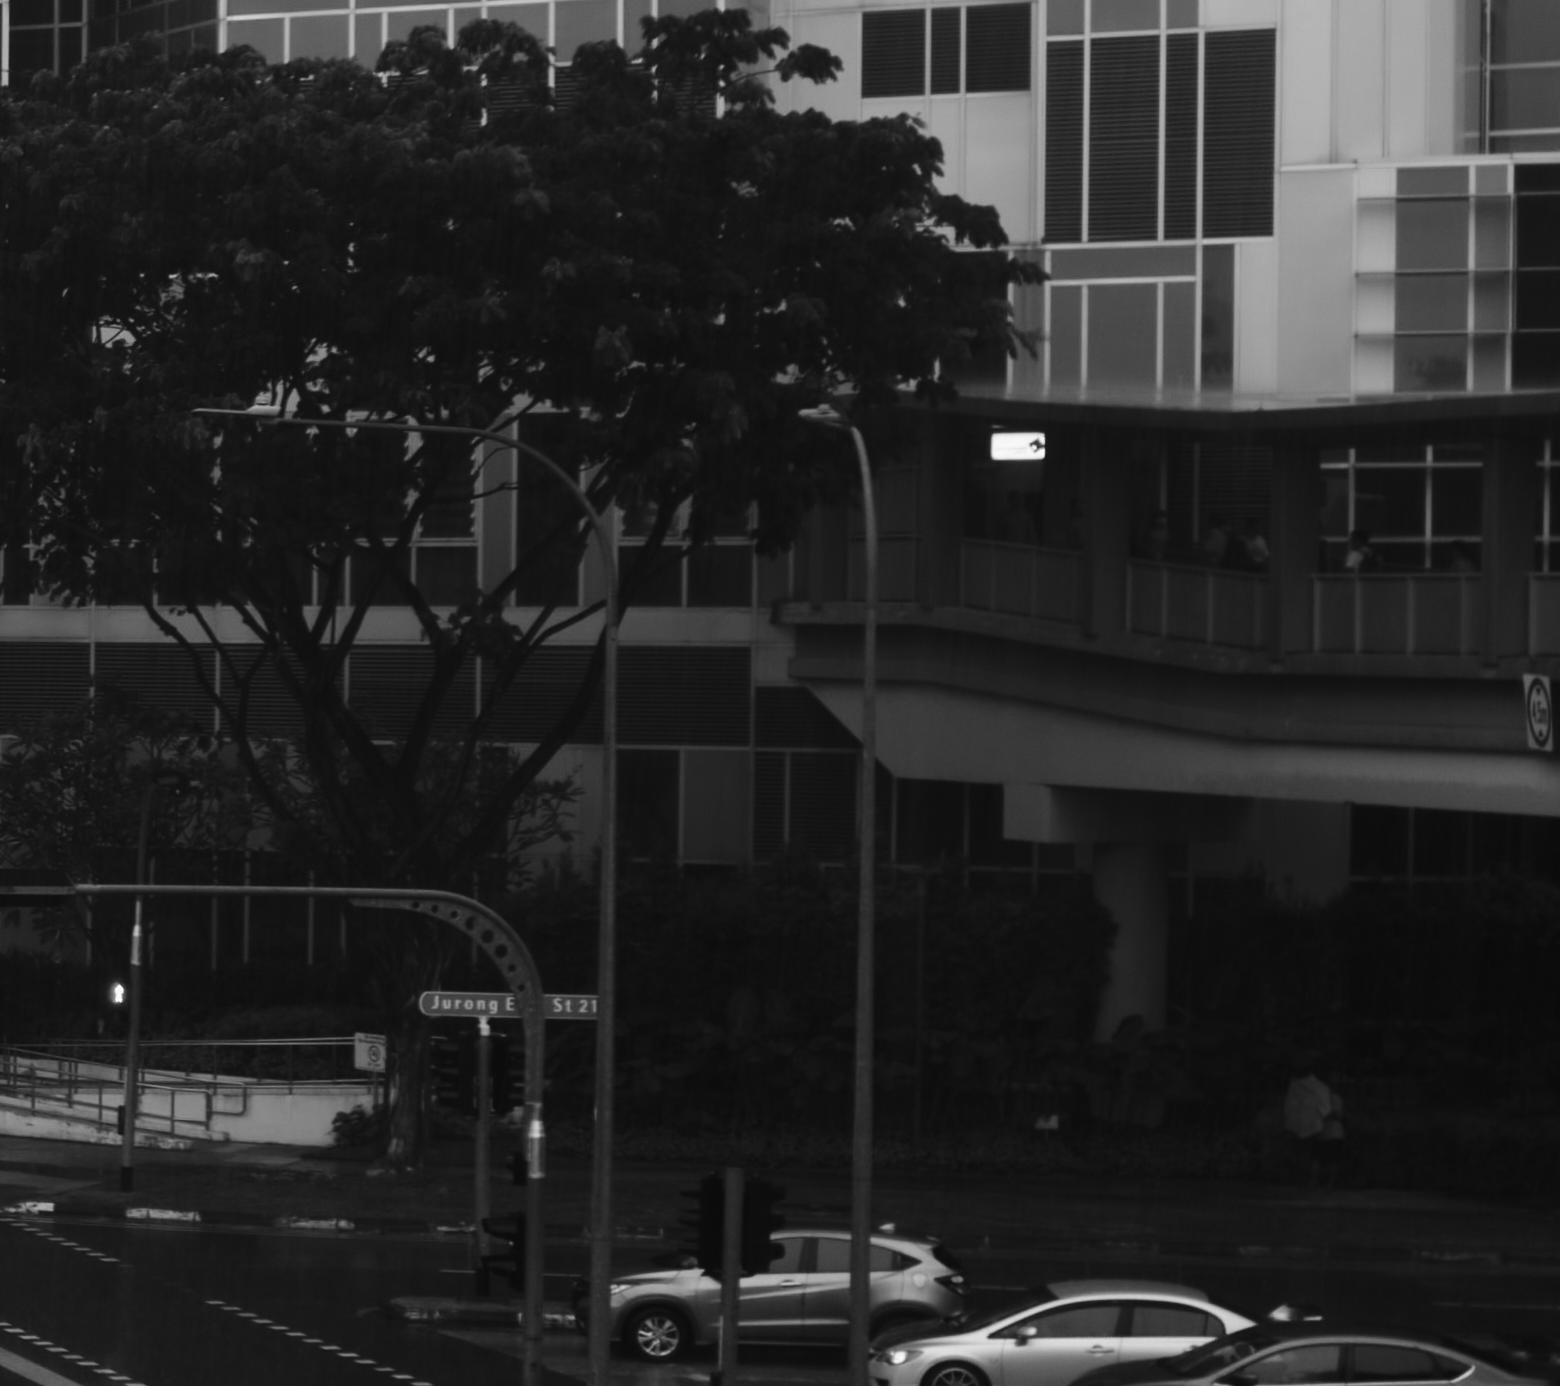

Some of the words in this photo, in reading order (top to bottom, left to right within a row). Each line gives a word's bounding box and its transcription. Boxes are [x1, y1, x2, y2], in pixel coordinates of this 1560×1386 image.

[430, 995, 499, 1015] Jurong
[552, 997, 573, 1013] St
[578, 999, 599, 1014] 21
